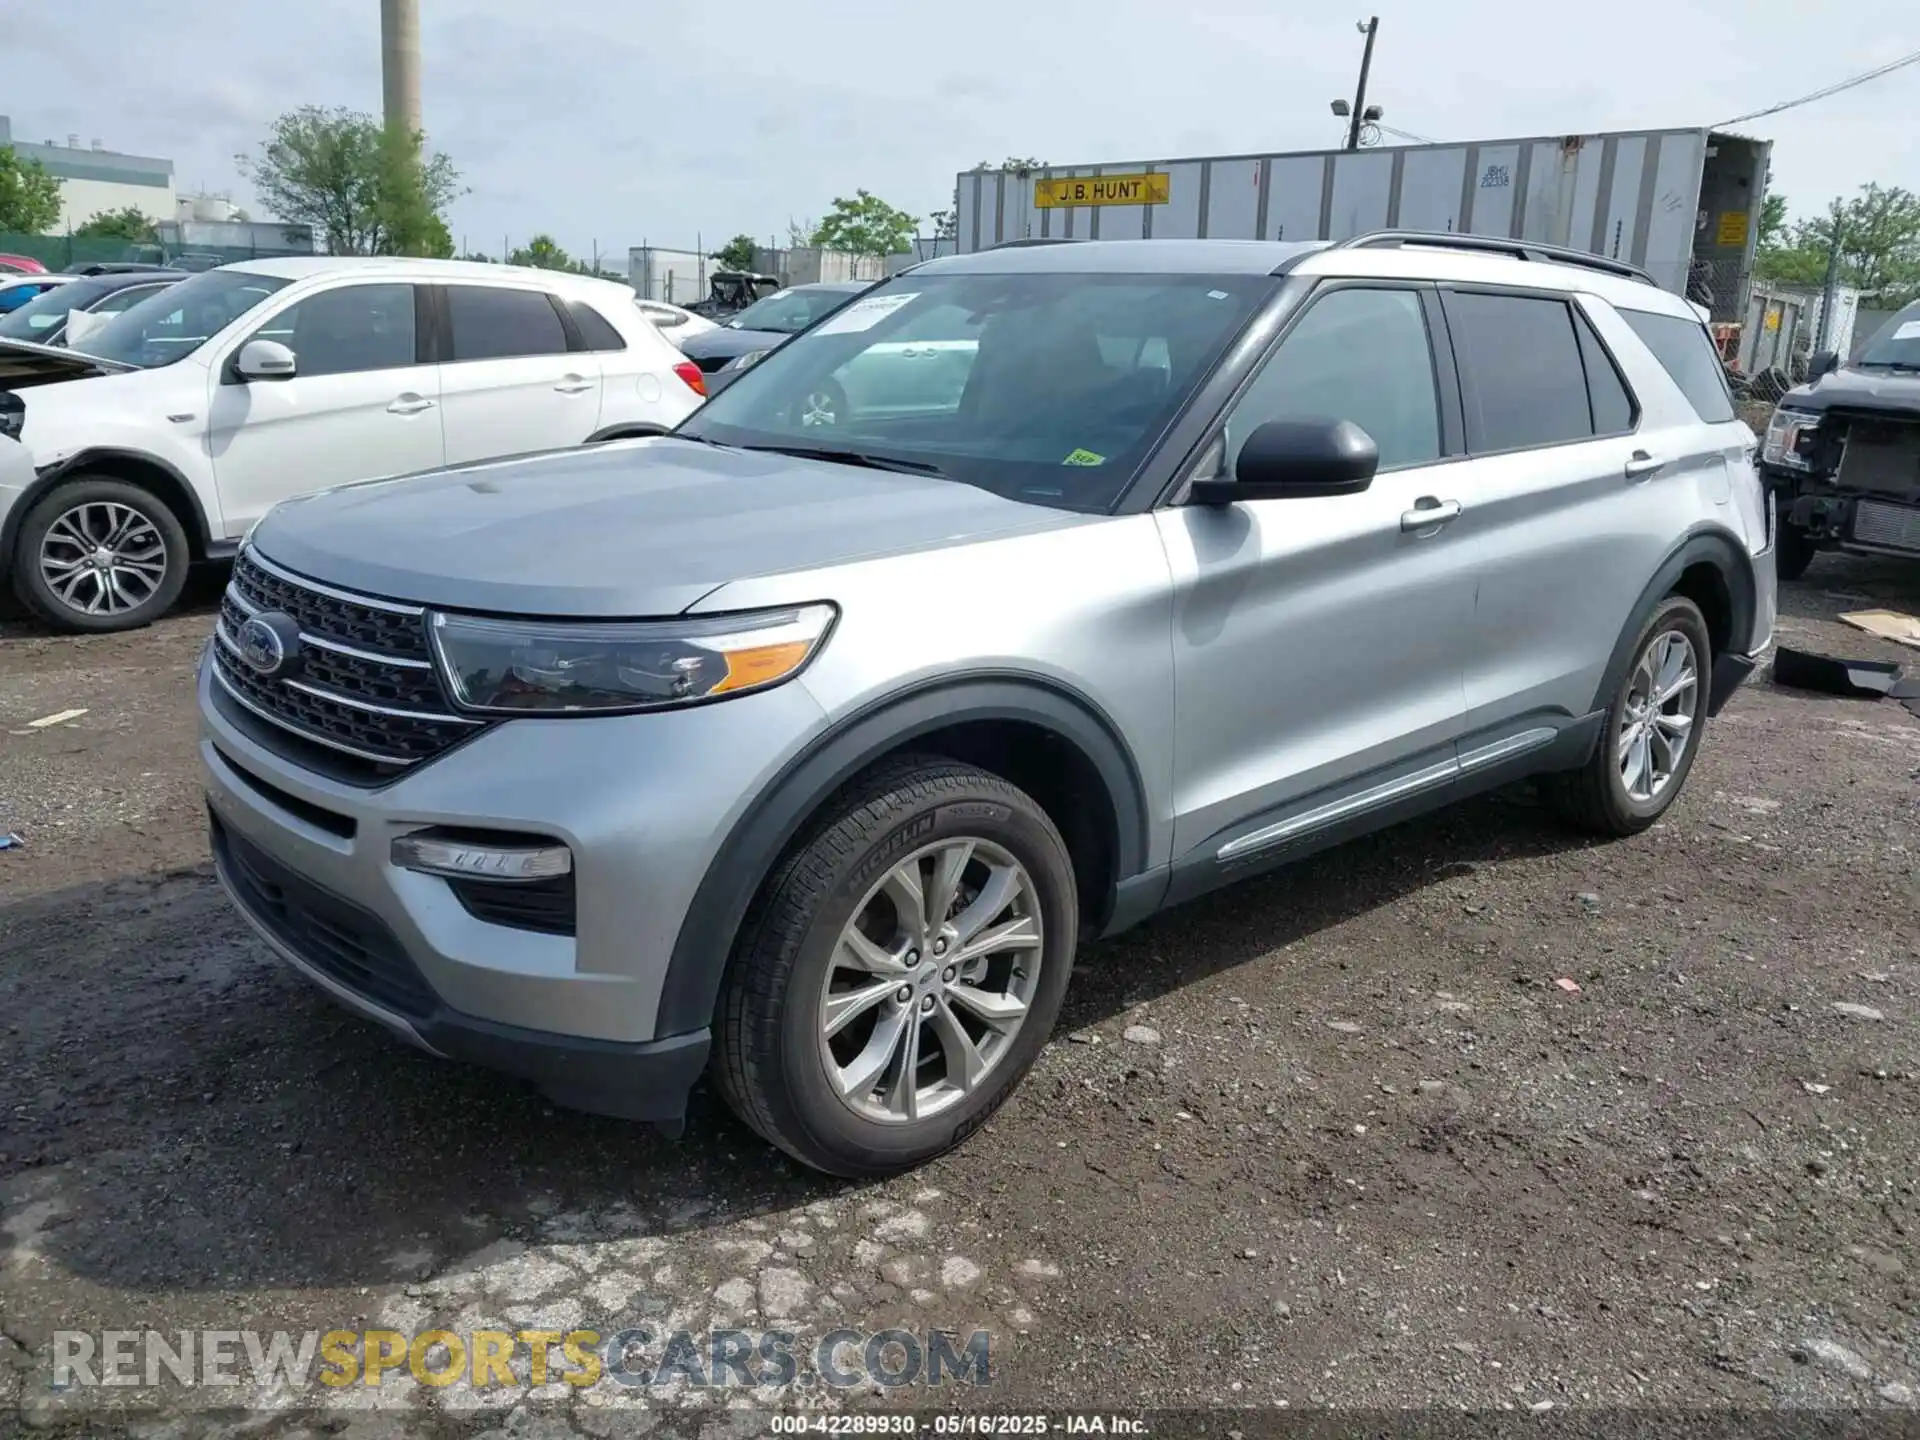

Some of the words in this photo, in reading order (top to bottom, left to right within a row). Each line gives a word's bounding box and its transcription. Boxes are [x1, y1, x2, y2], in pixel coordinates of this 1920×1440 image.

[1060, 184, 1072, 201] J.
[1075, 184, 1089, 200] B.
[1094, 181, 1141, 199] HUNT
[850, 812, 935, 888] MICHELIN
